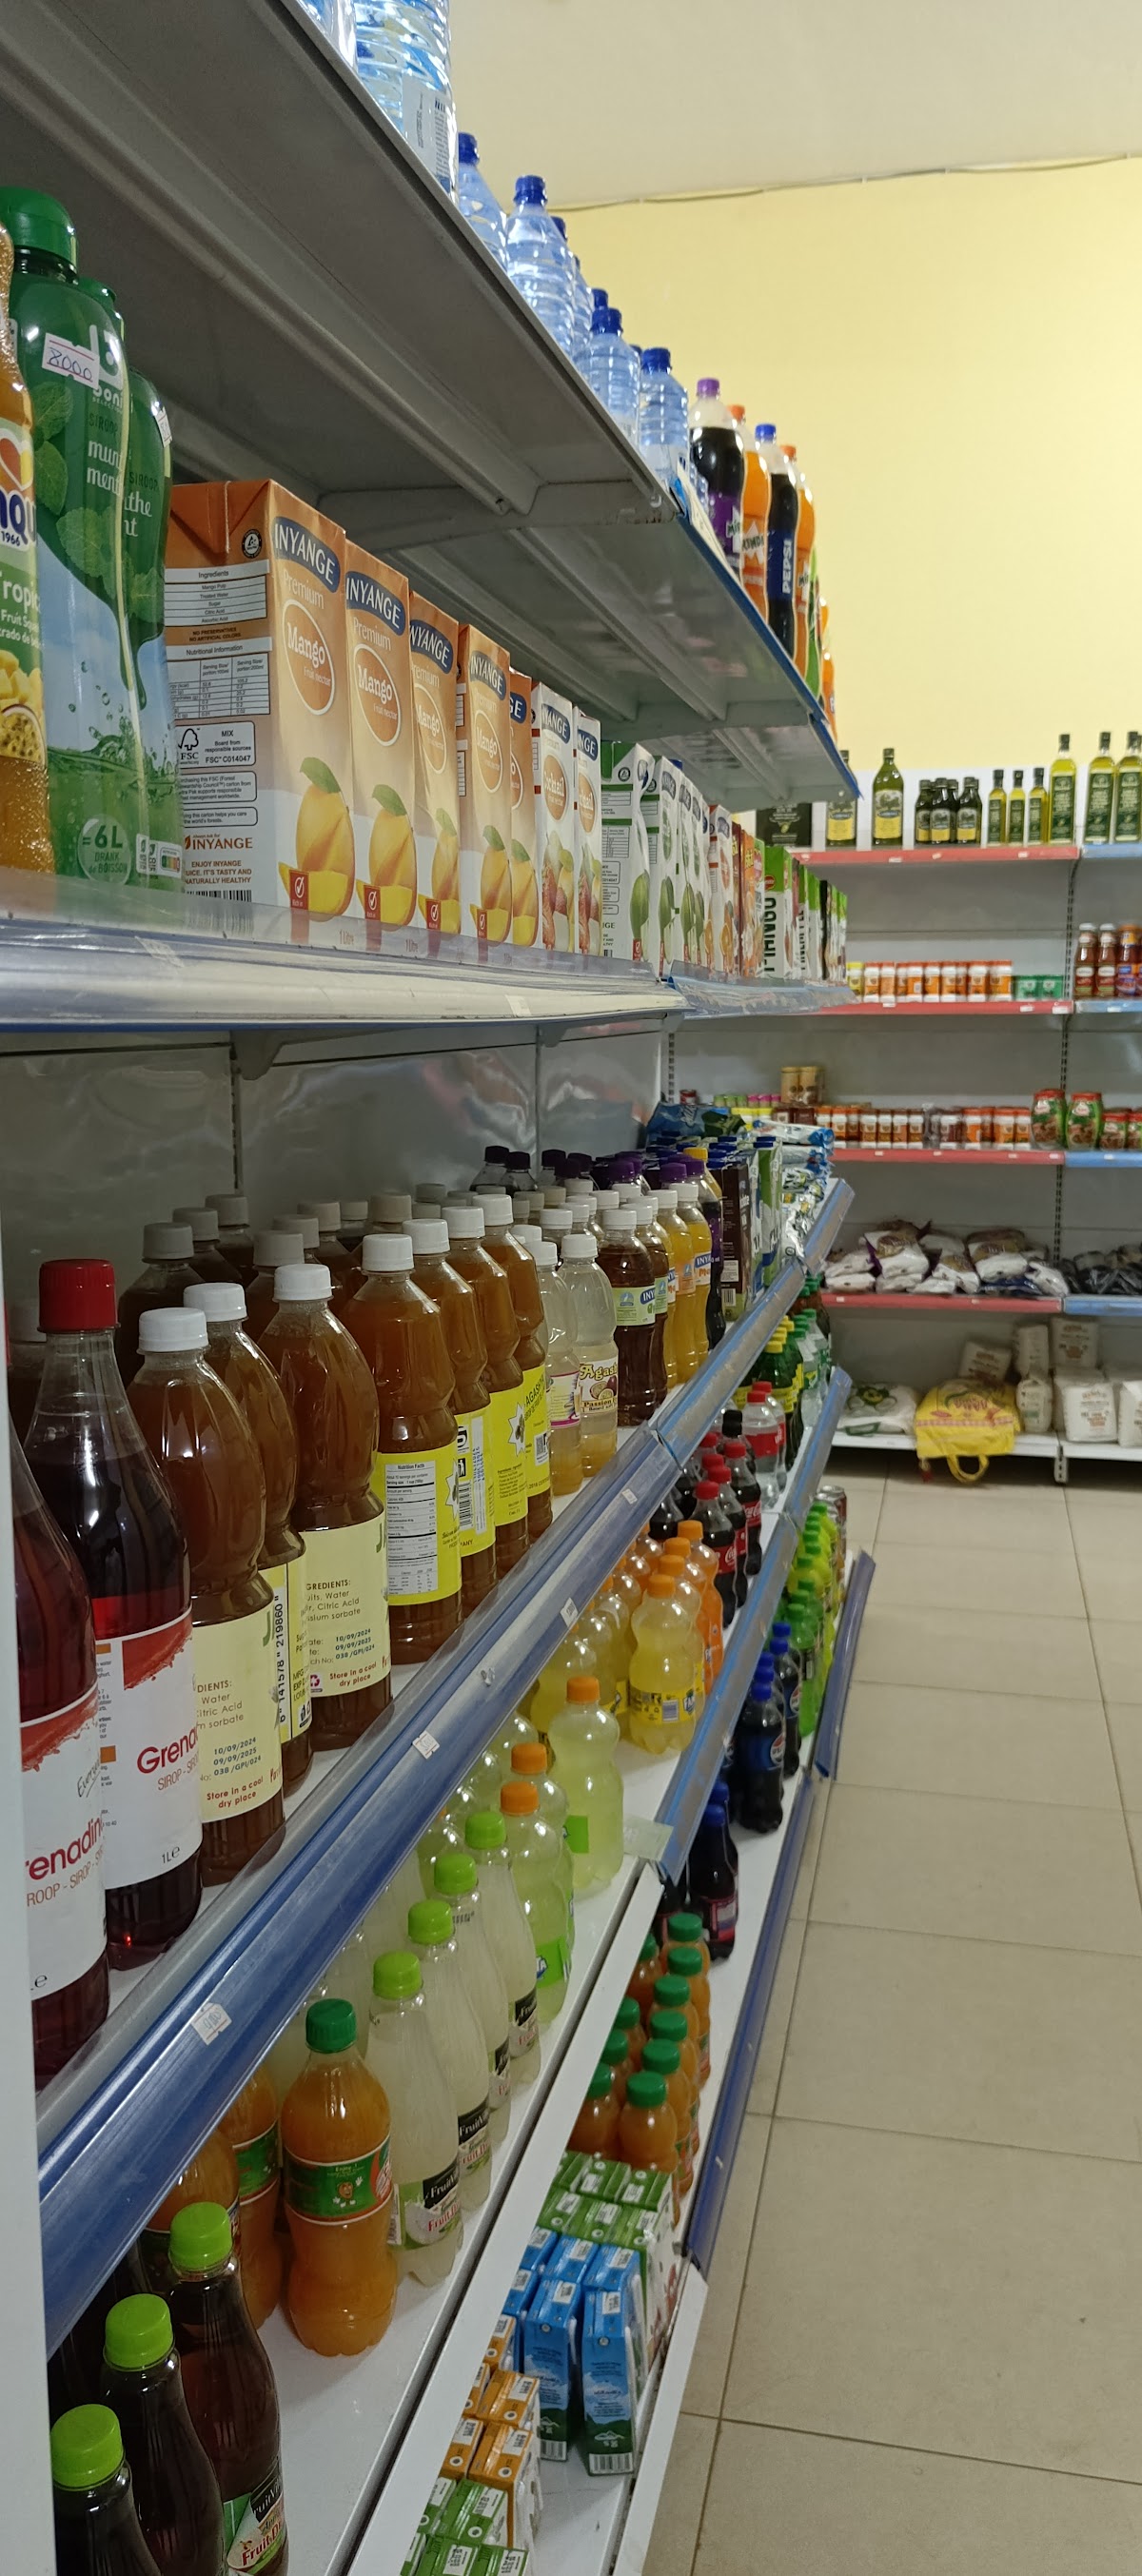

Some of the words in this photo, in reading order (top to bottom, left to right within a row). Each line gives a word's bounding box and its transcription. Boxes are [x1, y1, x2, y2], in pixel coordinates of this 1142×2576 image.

[49, 349, 93, 382] 8000
[1, 531, 20, 546] 1966
[275, 523, 336, 585] INYANGE
[782, 540, 792, 594] PEPSI
[284, 569, 324, 609] Premium
[346, 578, 401, 629] INYANGE
[1, 609, 22, 626] Fruit
[353, 617, 391, 651] Premium
[287, 622, 325, 668] Mango
[358, 664, 392, 704] Mango
[412, 665, 440, 688] remium
[471, 655, 503, 696] INYANGE
[192, 837, 253, 850] INYANGE
[317, 1600, 340, 1610] Citric
[342, 1598, 360, 1607] Acid
[325, 1590, 349, 1600] Water
[331, 1608, 361, 1620] sorbate
[275, 1603, 285, 1648] 219860
[335, 1628, 371, 1642] 10/09/2024
[335, 1636, 372, 1651] 09/09/2025
[276, 1660, 286, 1702] 141578
[329, 1670, 347, 1681] Store
[349, 1668, 356, 1677] in
[364, 1662, 377, 1673] cool
[340, 1679, 350, 1687] dry
[352, 1674, 371, 1684] place
[197, 1680, 233, 1693] DIENTS:
[201, 1693, 230, 1705] Water
[222, 1701, 243, 1715] Acid
[208, 1713, 245, 1727] sorbate
[213, 1737, 257, 1756] 10/09/2024
[213, 1746, 257, 1765] 09/09/2025
[214, 1766, 229, 1776] 038
[230, 1755, 262, 1774] /GPI/024
[157, 1770, 182, 1791] SIROP
[207, 1789, 228, 1801] Store
[231, 1786, 239, 1795] in
[248, 1776, 264, 1789] cool
[218, 1798, 232, 1809] dry
[234, 1791, 257, 1805] place
[25, 1817, 103, 1880] enadin
[27, 1882, 61, 1906] ROOP
[69, 1861, 91, 1890] SIROP
[428, 2209, 451, 2232] Fruit
[242, 2536, 269, 2566] Fruit
